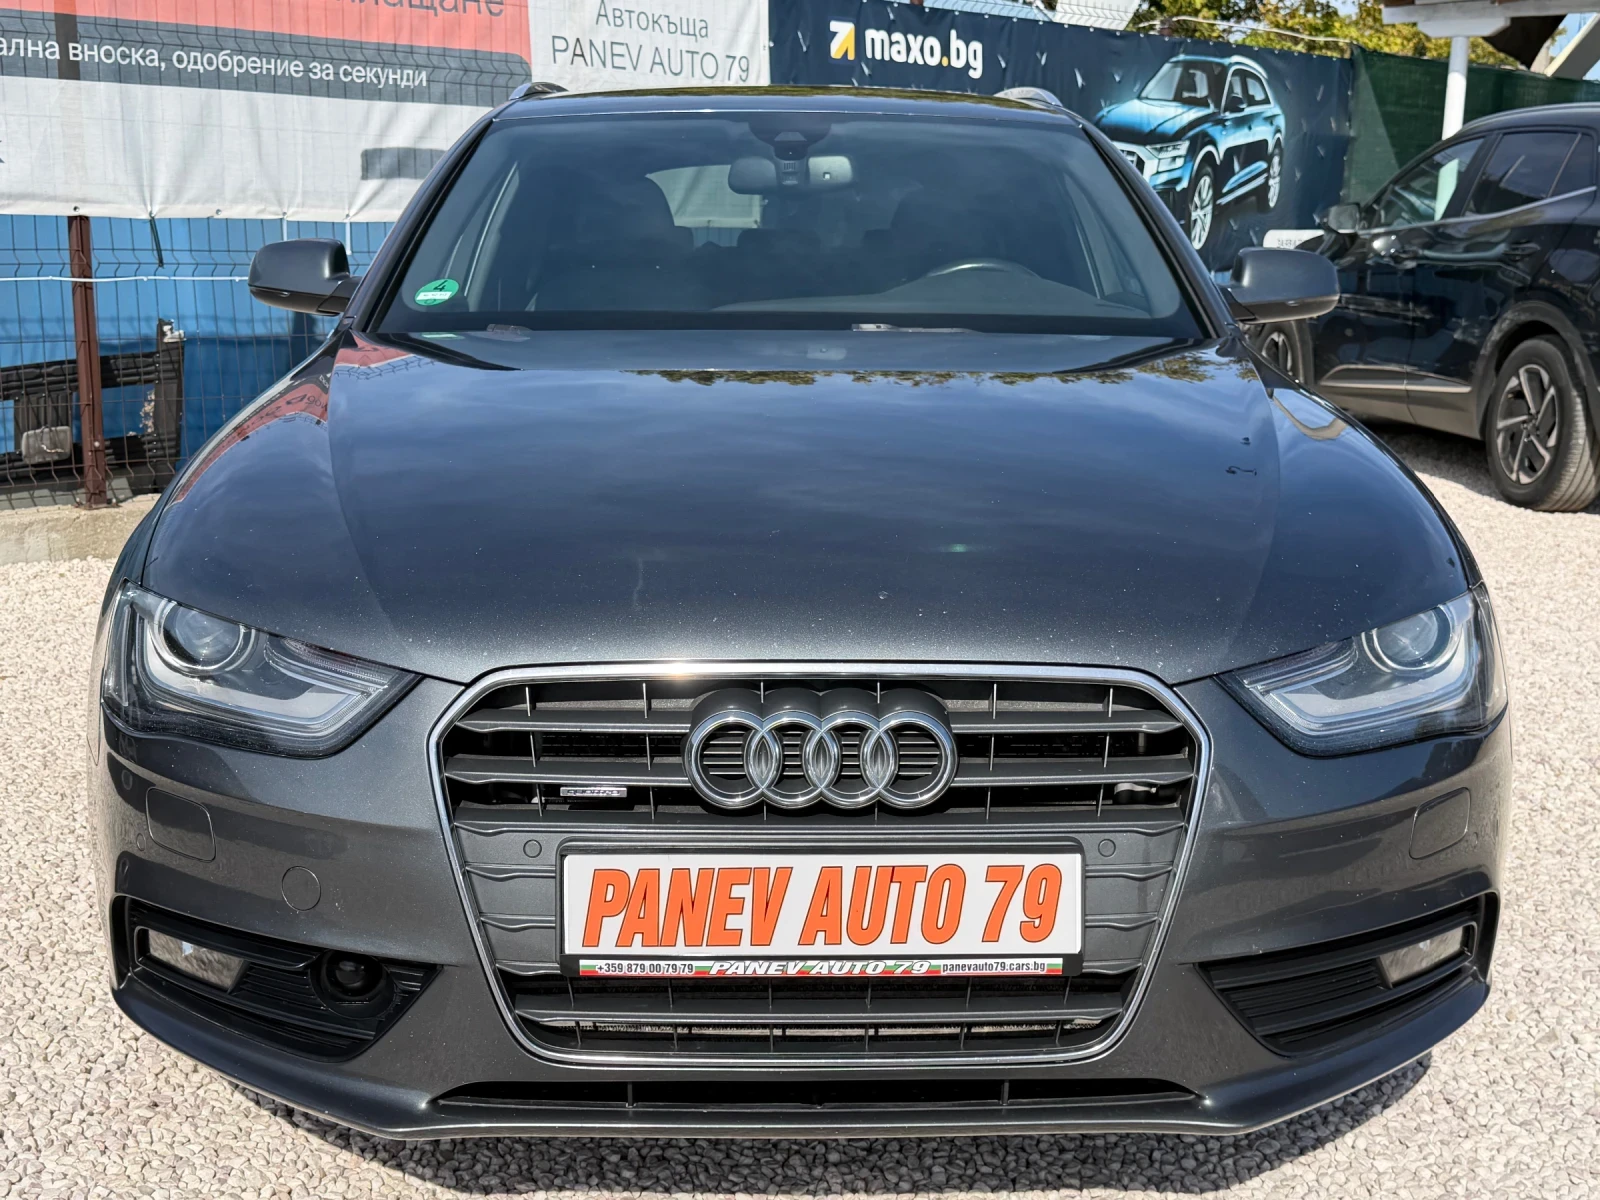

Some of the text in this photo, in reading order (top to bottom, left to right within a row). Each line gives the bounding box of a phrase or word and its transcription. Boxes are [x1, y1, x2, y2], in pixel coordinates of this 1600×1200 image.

[595, 1, 708, 42] Автокъща
[68, 42, 166, 71] вноска,
[172, 49, 304, 77] одобрение
[308, 61, 334, 80] за
[339, 64, 427, 89] секунди
[551, 35, 750, 83] PANEV AUTO 79
[865, 28, 983, 79] maxo.bg
[582, 863, 1063, 947] PANEV AUTO 79
[597, 962, 694, 974] +359 879 00 79 79
[709, 960, 931, 975] PANEV AUTO 79
[942, 961, 1046, 973] panevauto79.cars.bg
